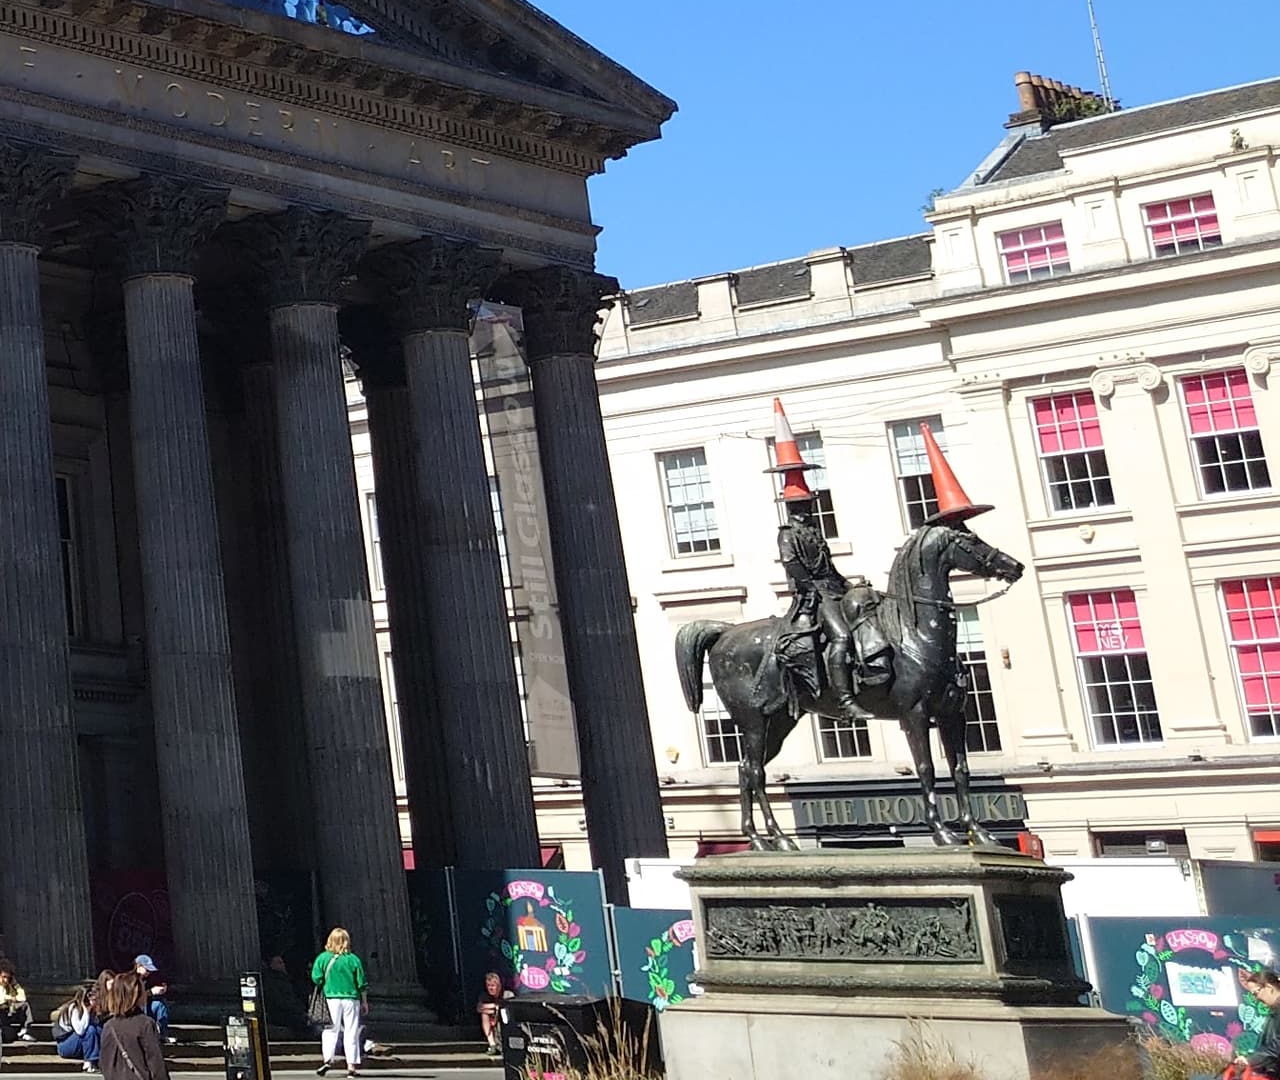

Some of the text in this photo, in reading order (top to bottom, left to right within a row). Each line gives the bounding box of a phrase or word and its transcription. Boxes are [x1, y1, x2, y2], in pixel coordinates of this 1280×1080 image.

[801, 793, 1025, 825] THE IRON DUKE
